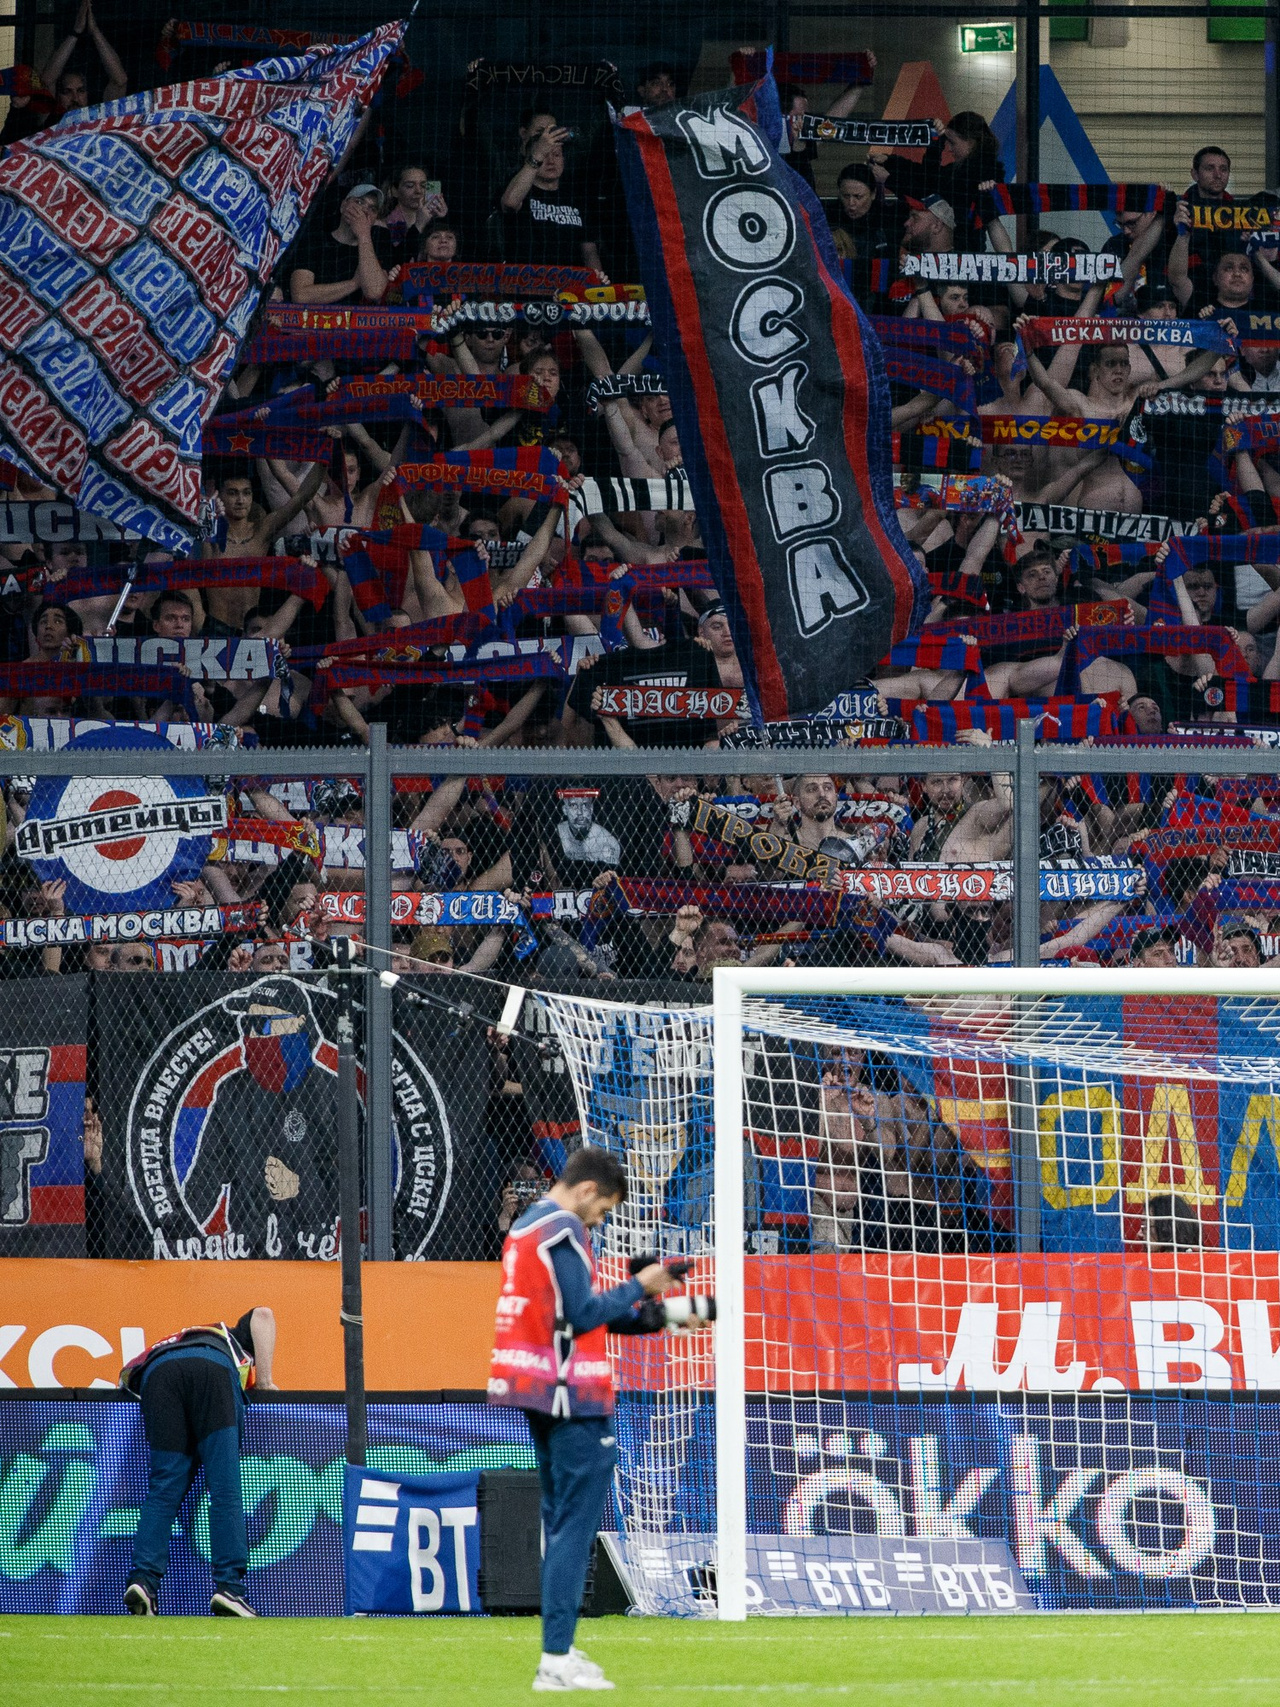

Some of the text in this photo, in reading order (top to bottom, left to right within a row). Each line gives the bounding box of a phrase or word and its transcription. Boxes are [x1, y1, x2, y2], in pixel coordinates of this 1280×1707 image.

[1192, 204, 1273, 232] ЦСКА
[356, 314, 417, 328] МОСКВА
[1051, 327, 1194, 345] ЦСКА МОСКВА
[676, 106, 870, 638] МОСКВА
[350, 380, 499, 400] ПФК ЦСКА
[400, 463, 545, 492] ПФК ЦСКА
[92, 637, 271, 680] ЦСКА
[842, 871, 986, 900] КРАСНО
[5, 906, 222, 947] ЦСКА МОСКВА
[139, 1026, 218, 1219] ВСЕГДА ВМЕСТЕ!
[411, 1122, 431, 1139] С
[405, 1143, 437, 1219] ЦСКА!
[797, 1561, 892, 1607] ВТБ
[931, 1563, 1017, 1608] ВТБ
